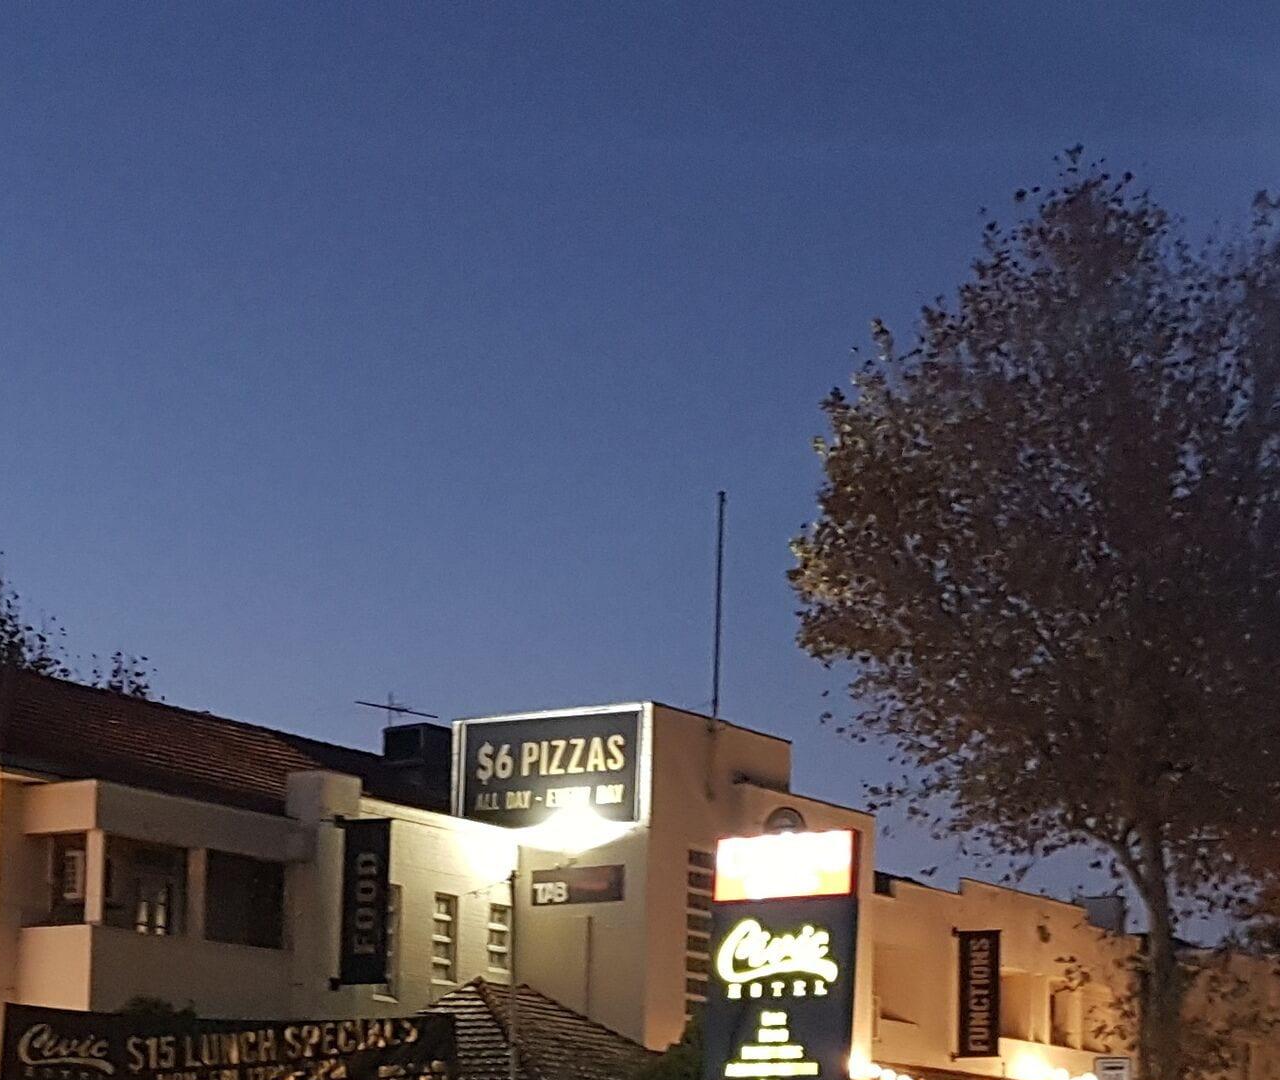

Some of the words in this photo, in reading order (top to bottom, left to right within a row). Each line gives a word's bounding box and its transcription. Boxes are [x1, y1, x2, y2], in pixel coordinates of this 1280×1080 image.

[476, 741, 514, 785] $6
[520, 734, 626, 777] PIZZAS
[475, 792, 500, 811] ALL
[505, 790, 532, 809] DAY
[546, 786, 592, 808] EVY
[353, 853, 378, 955] FOOD
[533, 881, 570, 904] TAB
[717, 919, 838, 983] Civic
[969, 937, 991, 1051] FUNCTIONS
[18, 1023, 115, 1076] Civic
[126, 1035, 176, 1074] $15
[184, 1028, 277, 1067] LUNCH
[284, 1018, 419, 1059] SPECIALS
